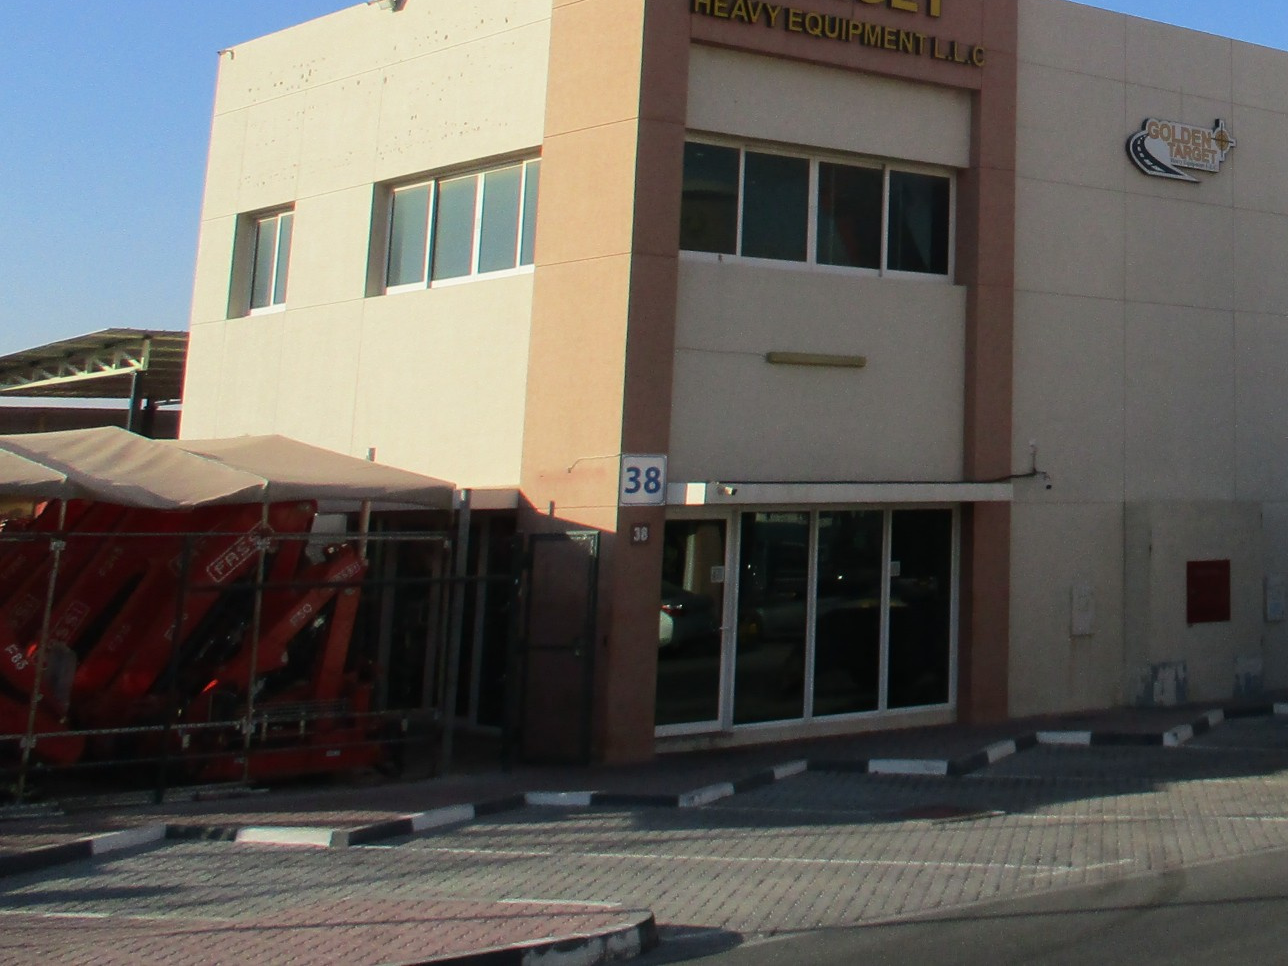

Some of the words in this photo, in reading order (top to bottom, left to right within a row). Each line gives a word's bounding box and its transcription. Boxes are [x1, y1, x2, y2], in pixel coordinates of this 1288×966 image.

[787, 8, 927, 55] EQUIPMENT
[933, 37, 986, 68] L.L.C
[1147, 121, 1212, 149] GOLDEN
[1167, 142, 1218, 164] TARGET
[624, 466, 662, 494] 38
[633, 526, 649, 542] 38
